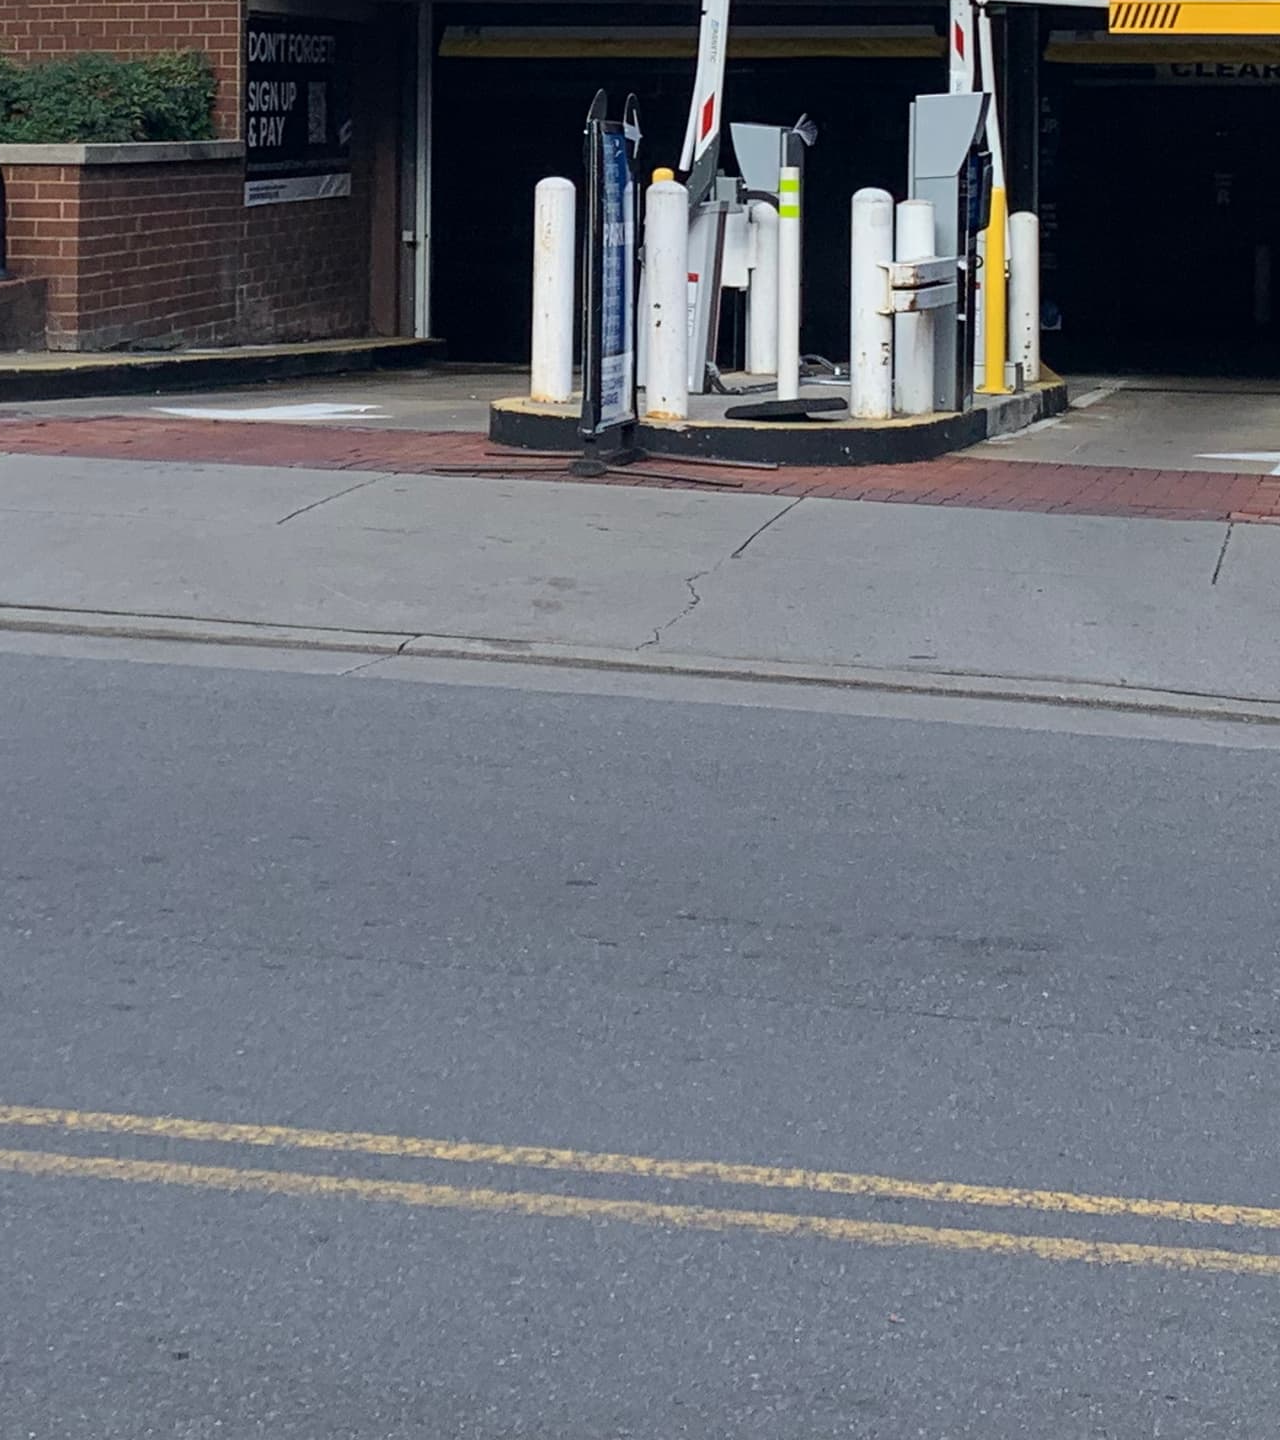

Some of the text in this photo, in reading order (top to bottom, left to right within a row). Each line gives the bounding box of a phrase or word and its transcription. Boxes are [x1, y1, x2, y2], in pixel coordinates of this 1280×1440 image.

[248, 31, 288, 63] DON'T
[248, 80, 297, 112] SIGN UP
[248, 116, 286, 148] & PAY
